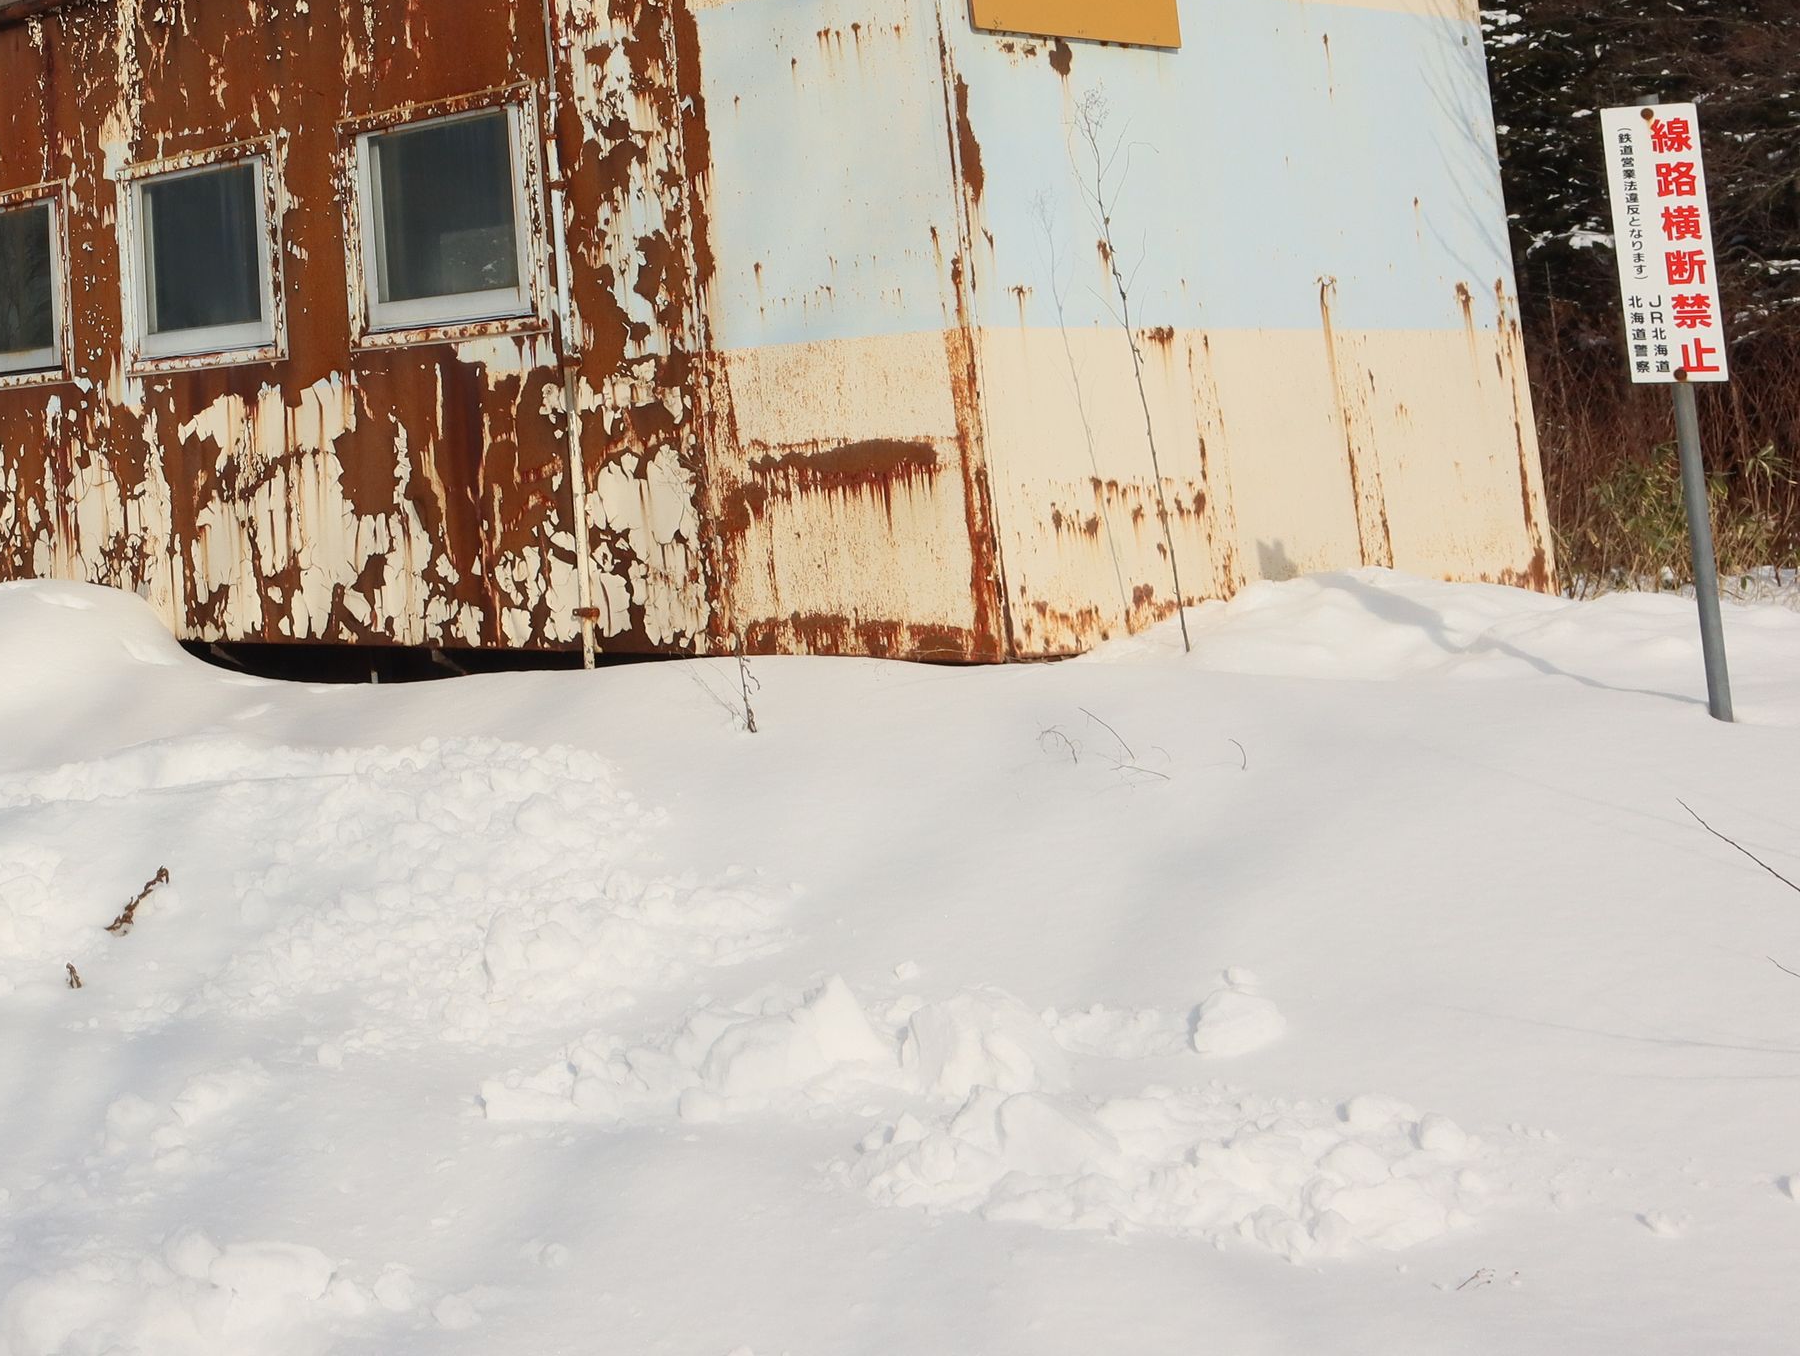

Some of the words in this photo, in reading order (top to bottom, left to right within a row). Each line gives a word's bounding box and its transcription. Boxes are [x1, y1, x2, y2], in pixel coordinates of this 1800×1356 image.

[1617, 128, 1648, 280] （鉄道営業法違反となります）
[1650, 118, 1719, 373] 線路横断禁止
[1628, 295, 1650, 373] 北海道警察
[1649, 295, 1670, 373] JR北海道
